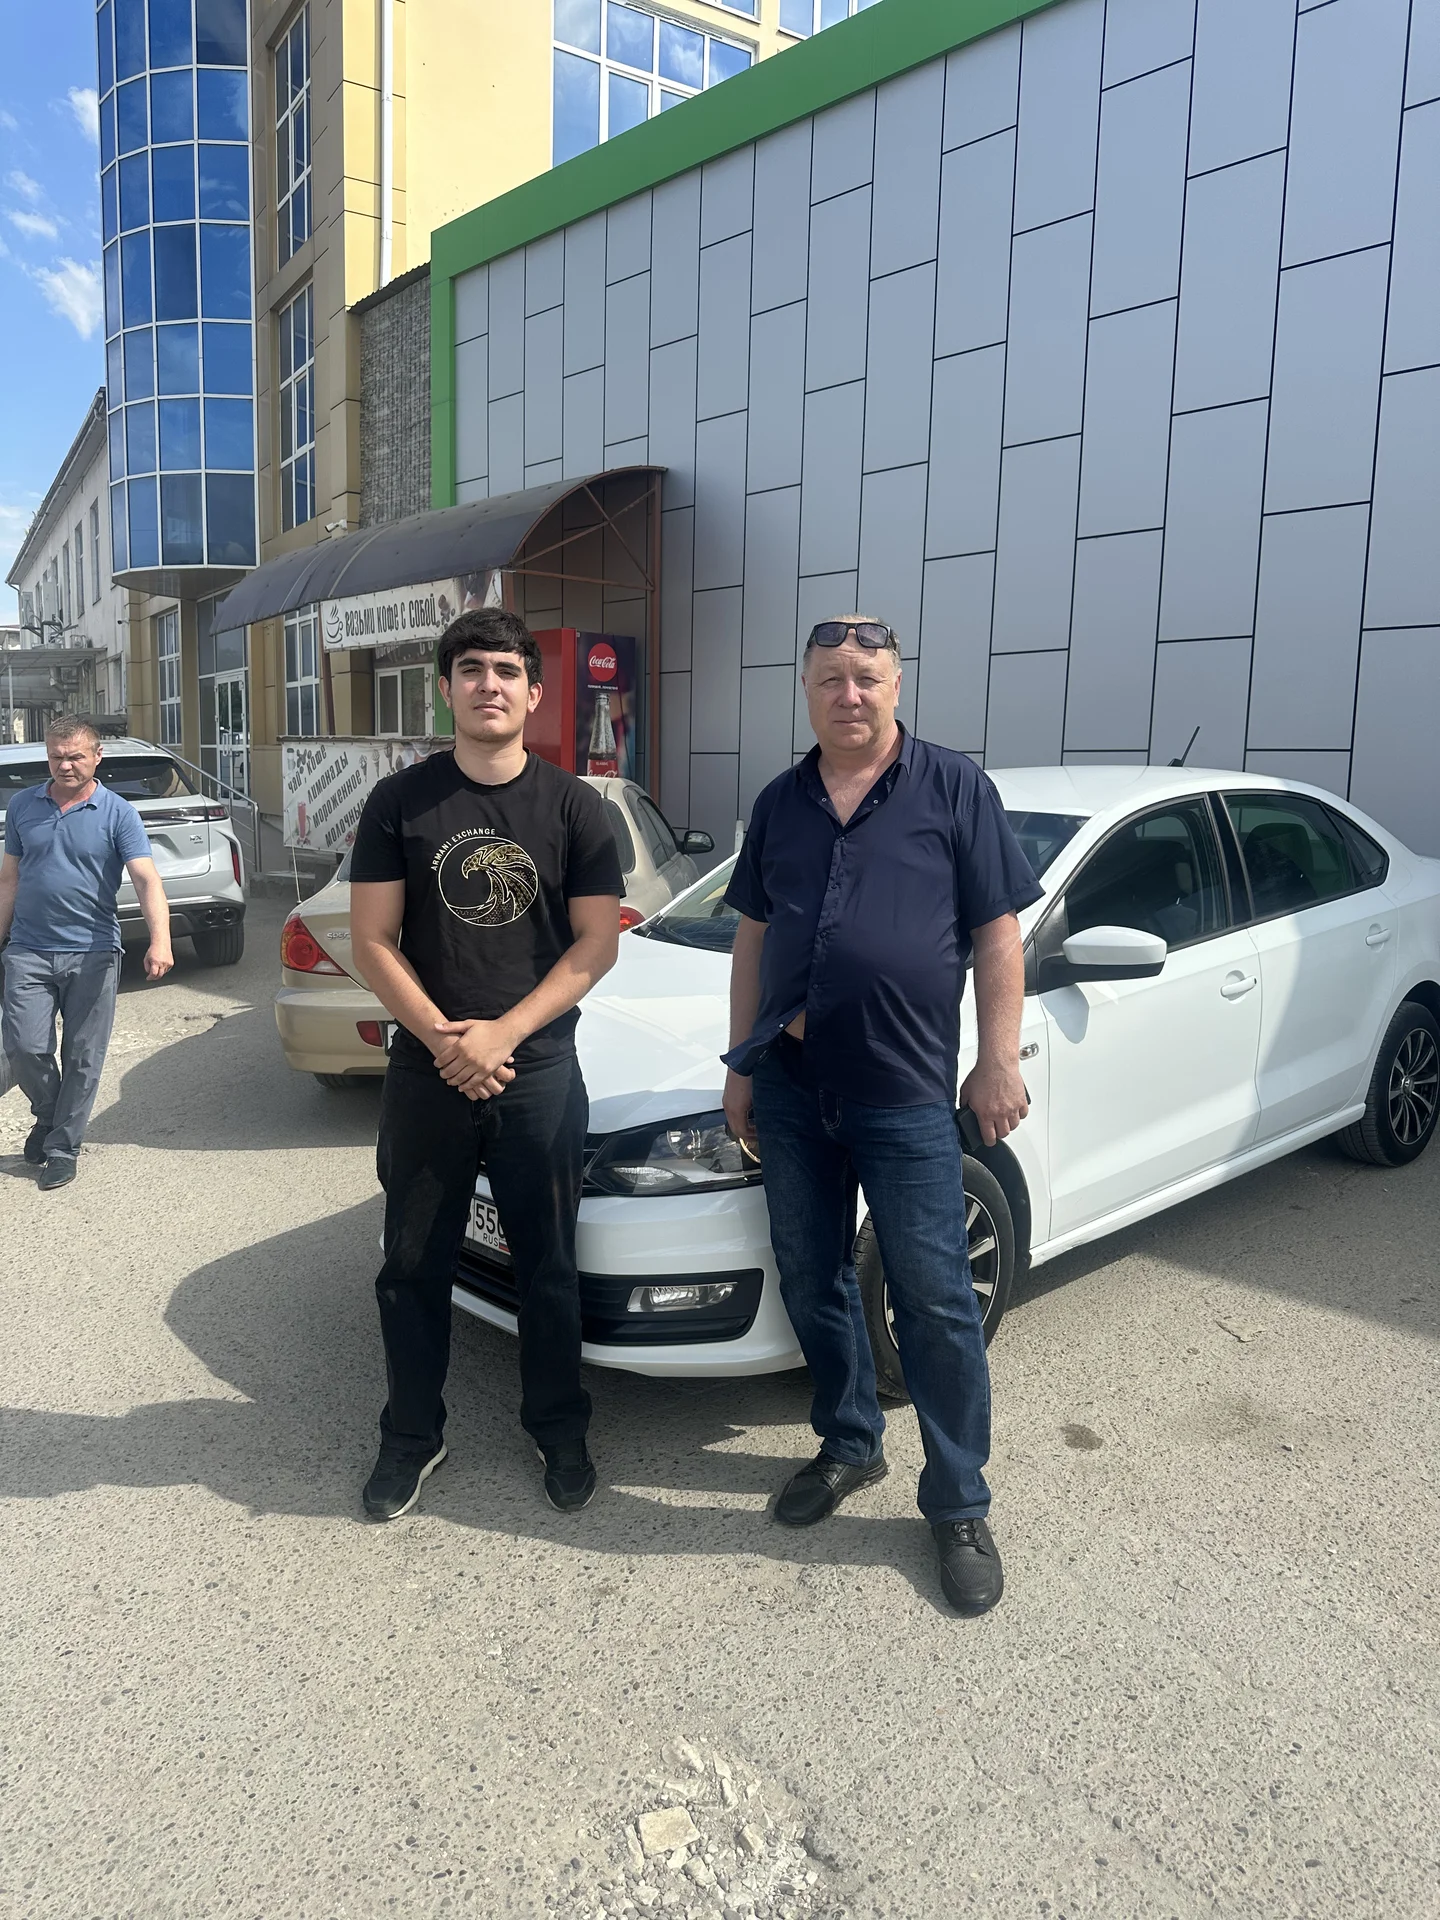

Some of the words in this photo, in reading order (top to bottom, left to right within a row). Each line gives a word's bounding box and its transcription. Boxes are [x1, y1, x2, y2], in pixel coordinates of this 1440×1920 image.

[430, 841, 452, 871] ARMANI
[451, 828, 496, 844] EXCHANGE
[482, 1232, 500, 1248] RUS
